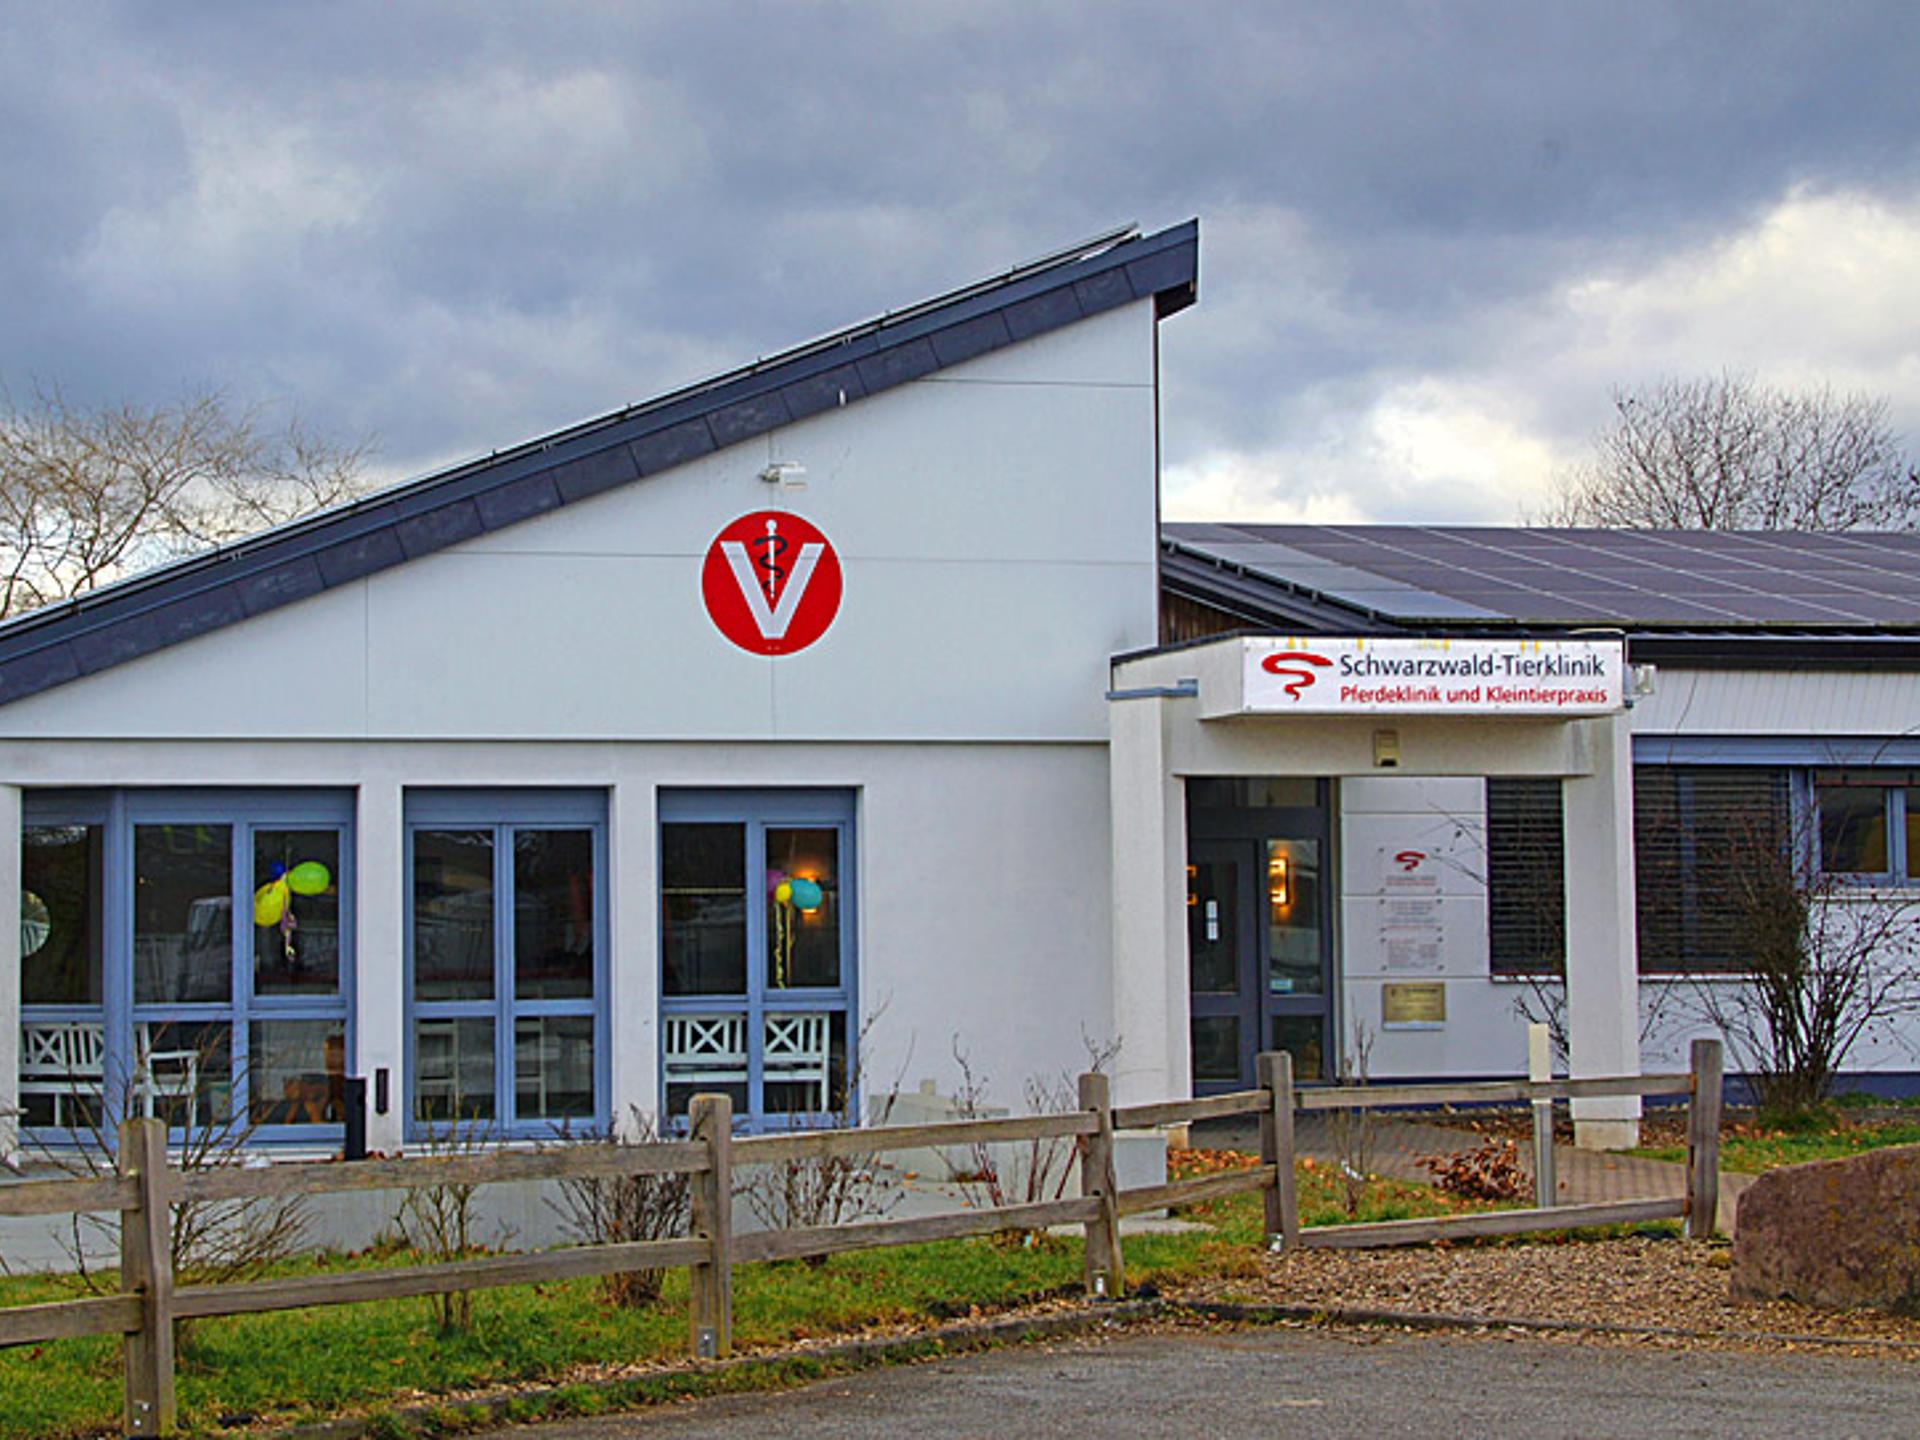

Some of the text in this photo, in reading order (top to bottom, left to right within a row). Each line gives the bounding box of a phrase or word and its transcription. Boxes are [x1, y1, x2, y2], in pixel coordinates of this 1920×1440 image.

[719, 541, 825, 639] V
[1340, 654, 1605, 677] Schwarzwald-Tierklinik
[1340, 686, 1607, 705] Pferdeklinik und Kleintierpraxis
